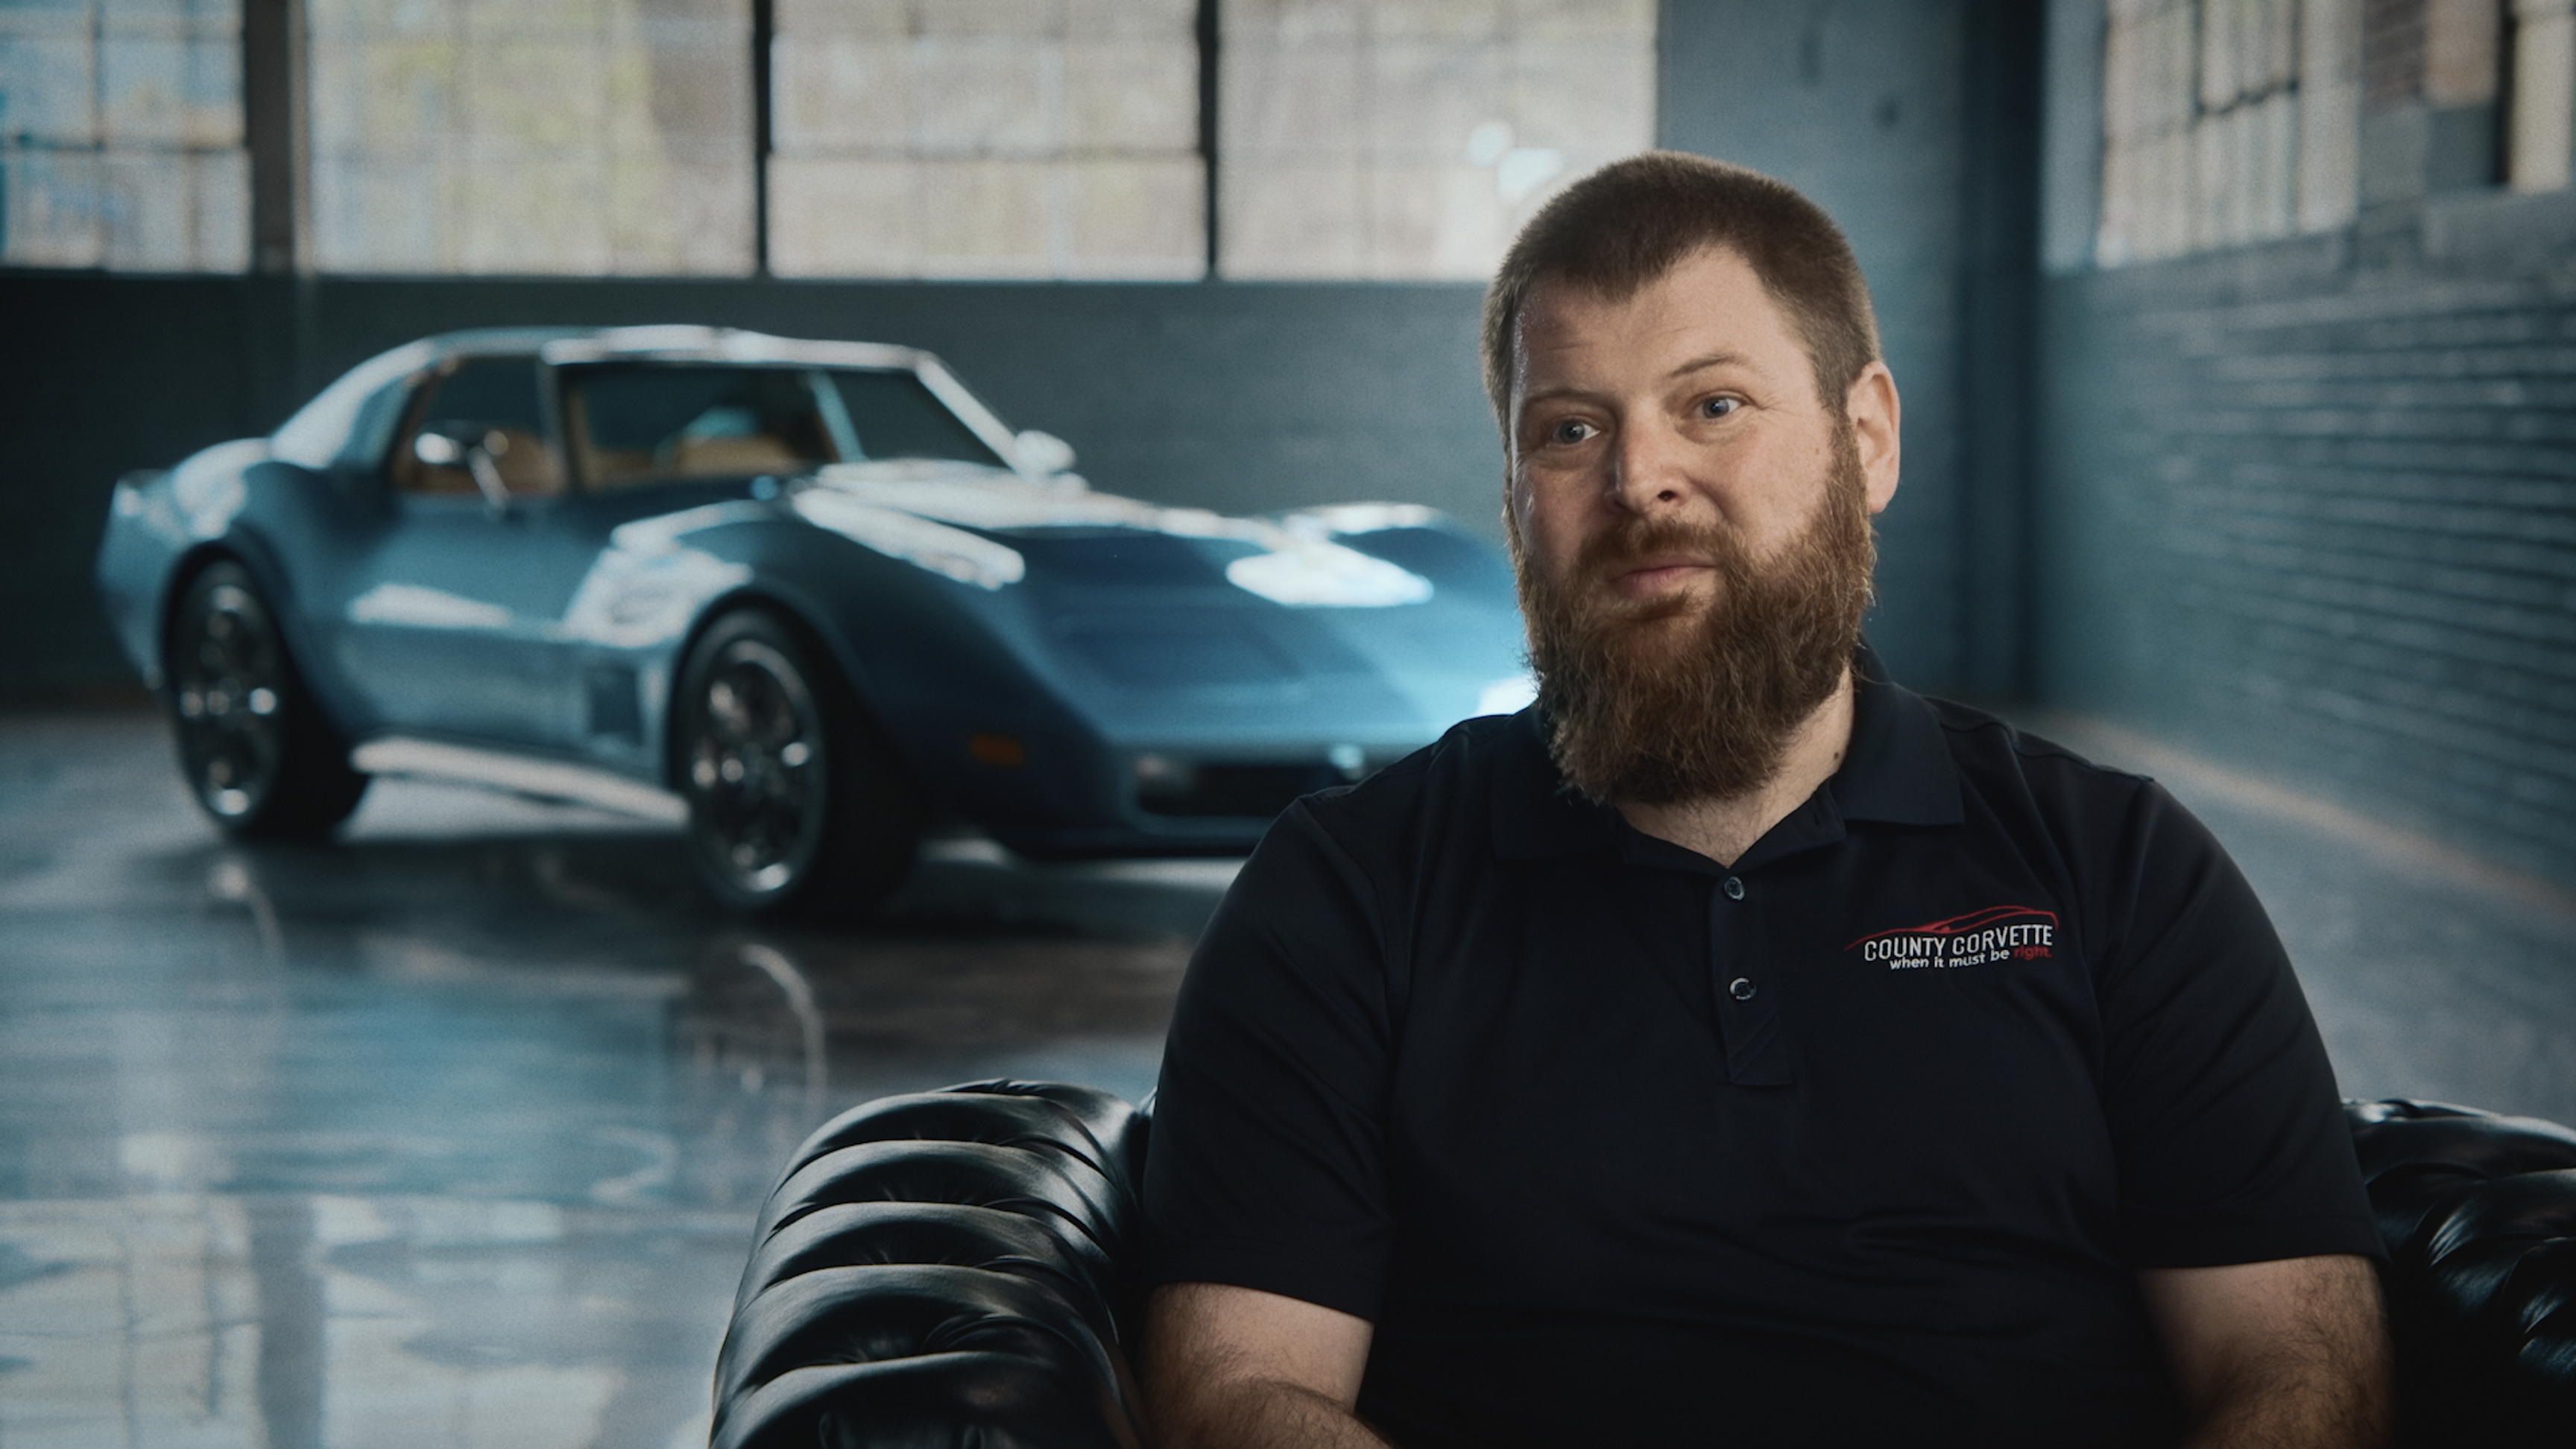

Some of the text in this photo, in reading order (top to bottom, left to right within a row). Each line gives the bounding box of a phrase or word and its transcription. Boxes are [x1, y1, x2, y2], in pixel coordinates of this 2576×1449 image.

[1864, 924, 2053, 962] COUNTY CORVETTE
[1890, 945, 2052, 970] when it must be right.
